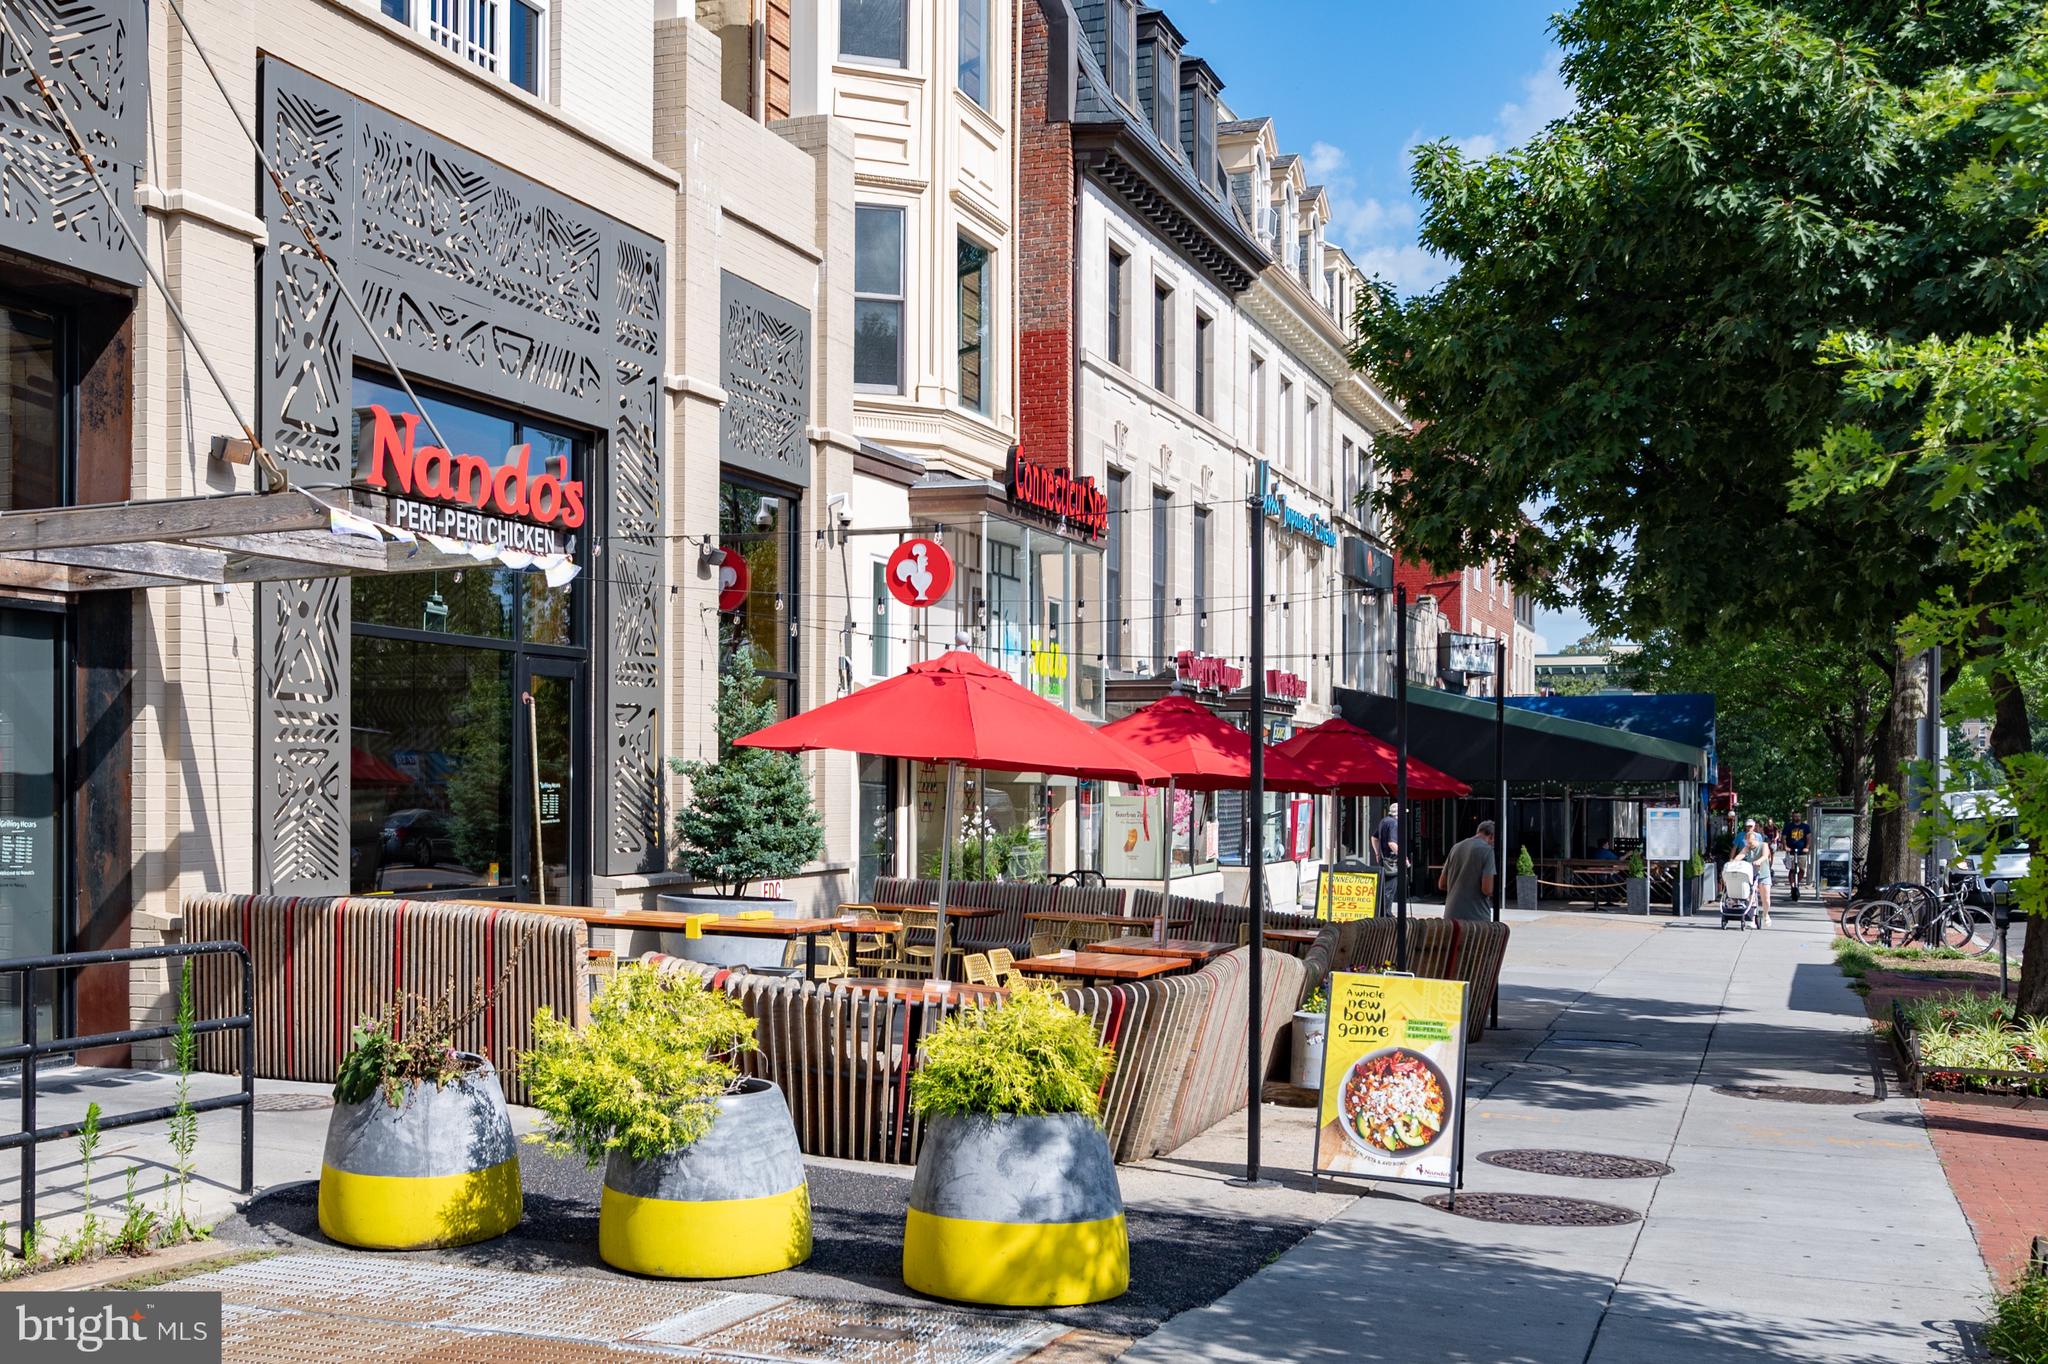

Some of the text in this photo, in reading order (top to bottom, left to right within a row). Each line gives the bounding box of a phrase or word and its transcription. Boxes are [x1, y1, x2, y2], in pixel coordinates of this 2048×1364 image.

[366, 404, 585, 529] Nando's
[1013, 445, 1108, 541] Connecticut Spa
[1281, 494, 1314, 535] Japanese
[487, 520, 556, 554] CHICKEN
[1029, 639, 1068, 680] Nails
[1355, 885, 1375, 897] SPA
[1346, 989, 1385, 999] A whole
[1348, 1000, 1380, 1010] new
[1343, 1007, 1386, 1023] bowl
[1338, 1023, 1389, 1038] game
